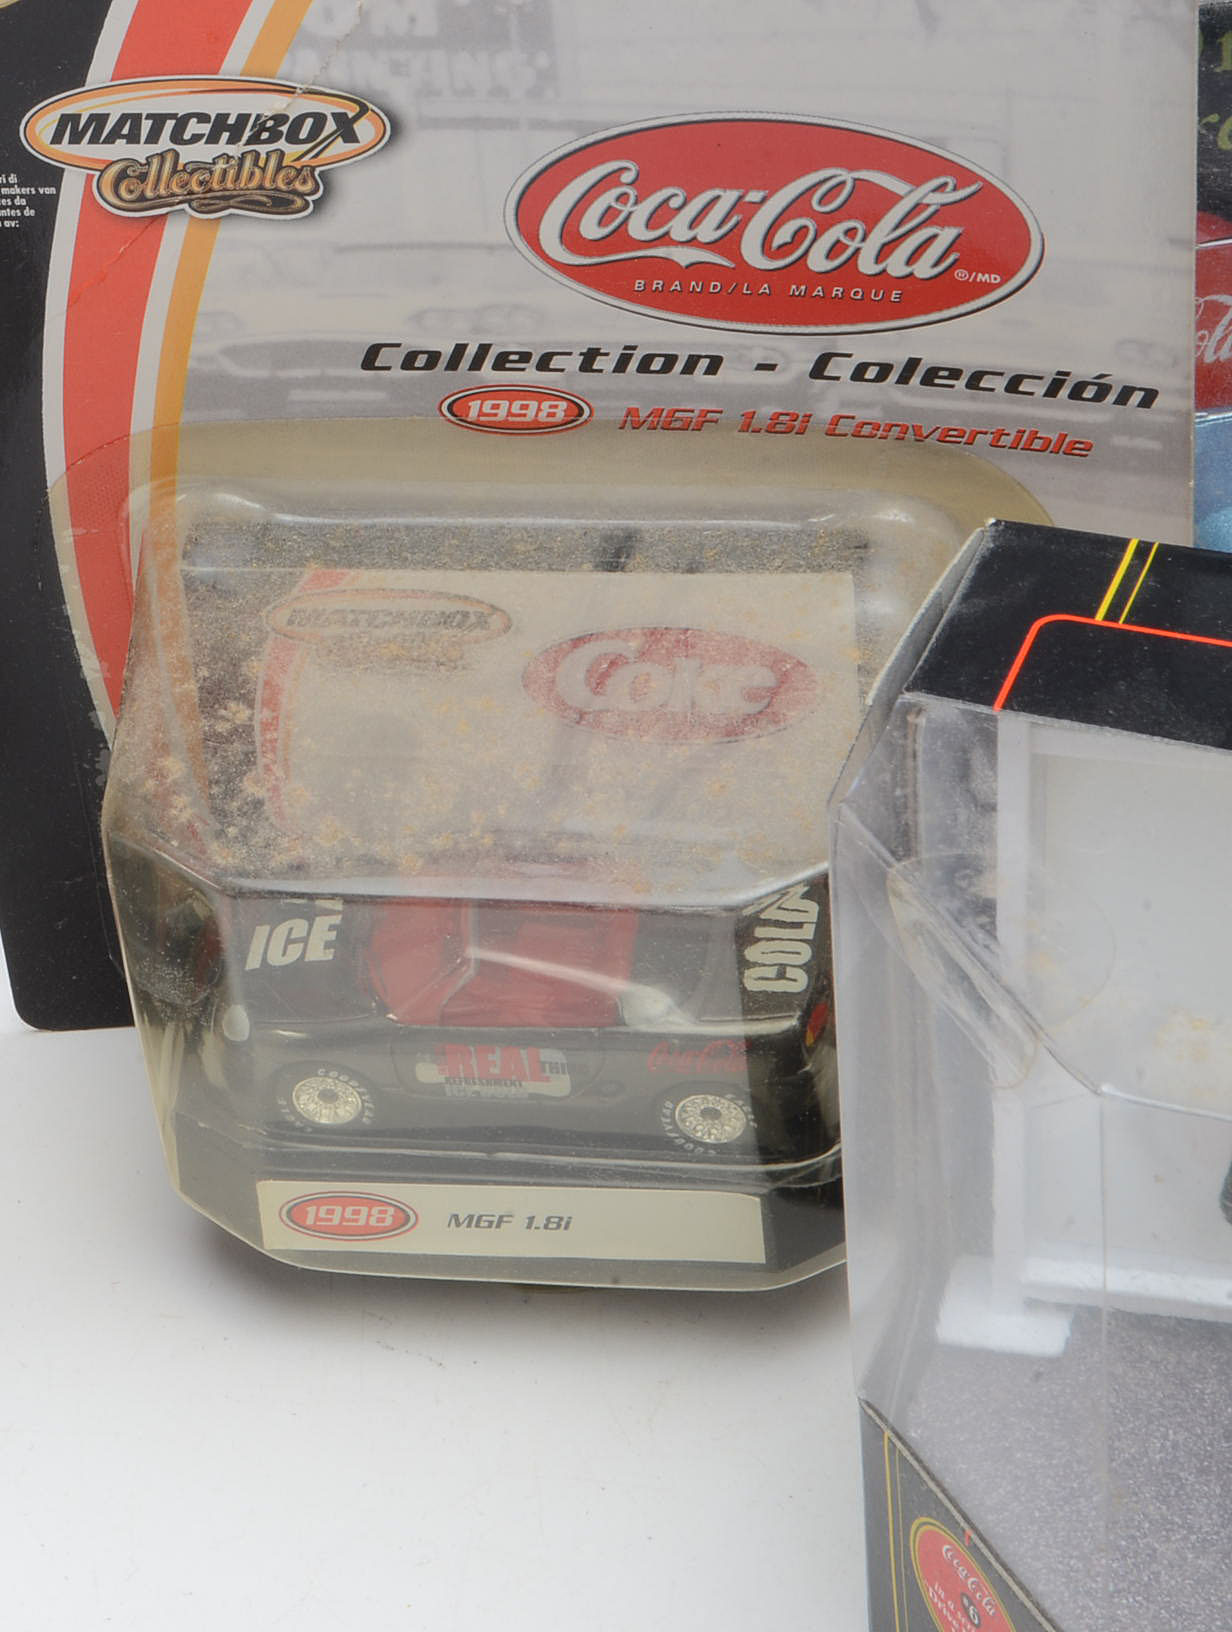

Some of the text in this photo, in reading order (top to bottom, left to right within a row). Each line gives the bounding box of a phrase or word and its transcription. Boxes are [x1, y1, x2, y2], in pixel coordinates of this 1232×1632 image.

[48, 110, 365, 148] MATCHBOX
[0, 184, 36, 195] makers
[37, 186, 56, 195] van
[8, 172, 18, 184] di
[100, 148, 317, 213] Collectibles
[14, 194, 27, 205] da
[23, 205, 36, 217] de
[3, 219, 20, 228] av:
[537, 159, 984, 281] Coca-Cola
[633, 279, 904, 305] BRAND/LA MARQUE
[359, 341, 723, 378] Collection
[808, 351, 1162, 410] Colección
[468, 399, 568, 422] 1998
[618, 406, 724, 432] MGF
[824, 412, 1095, 459] Convertible
[244, 914, 343, 972] ICE
[440, 1041, 551, 1083] REAL
[303, 1203, 396, 1228] 1998
[446, 1211, 515, 1230] MGF
